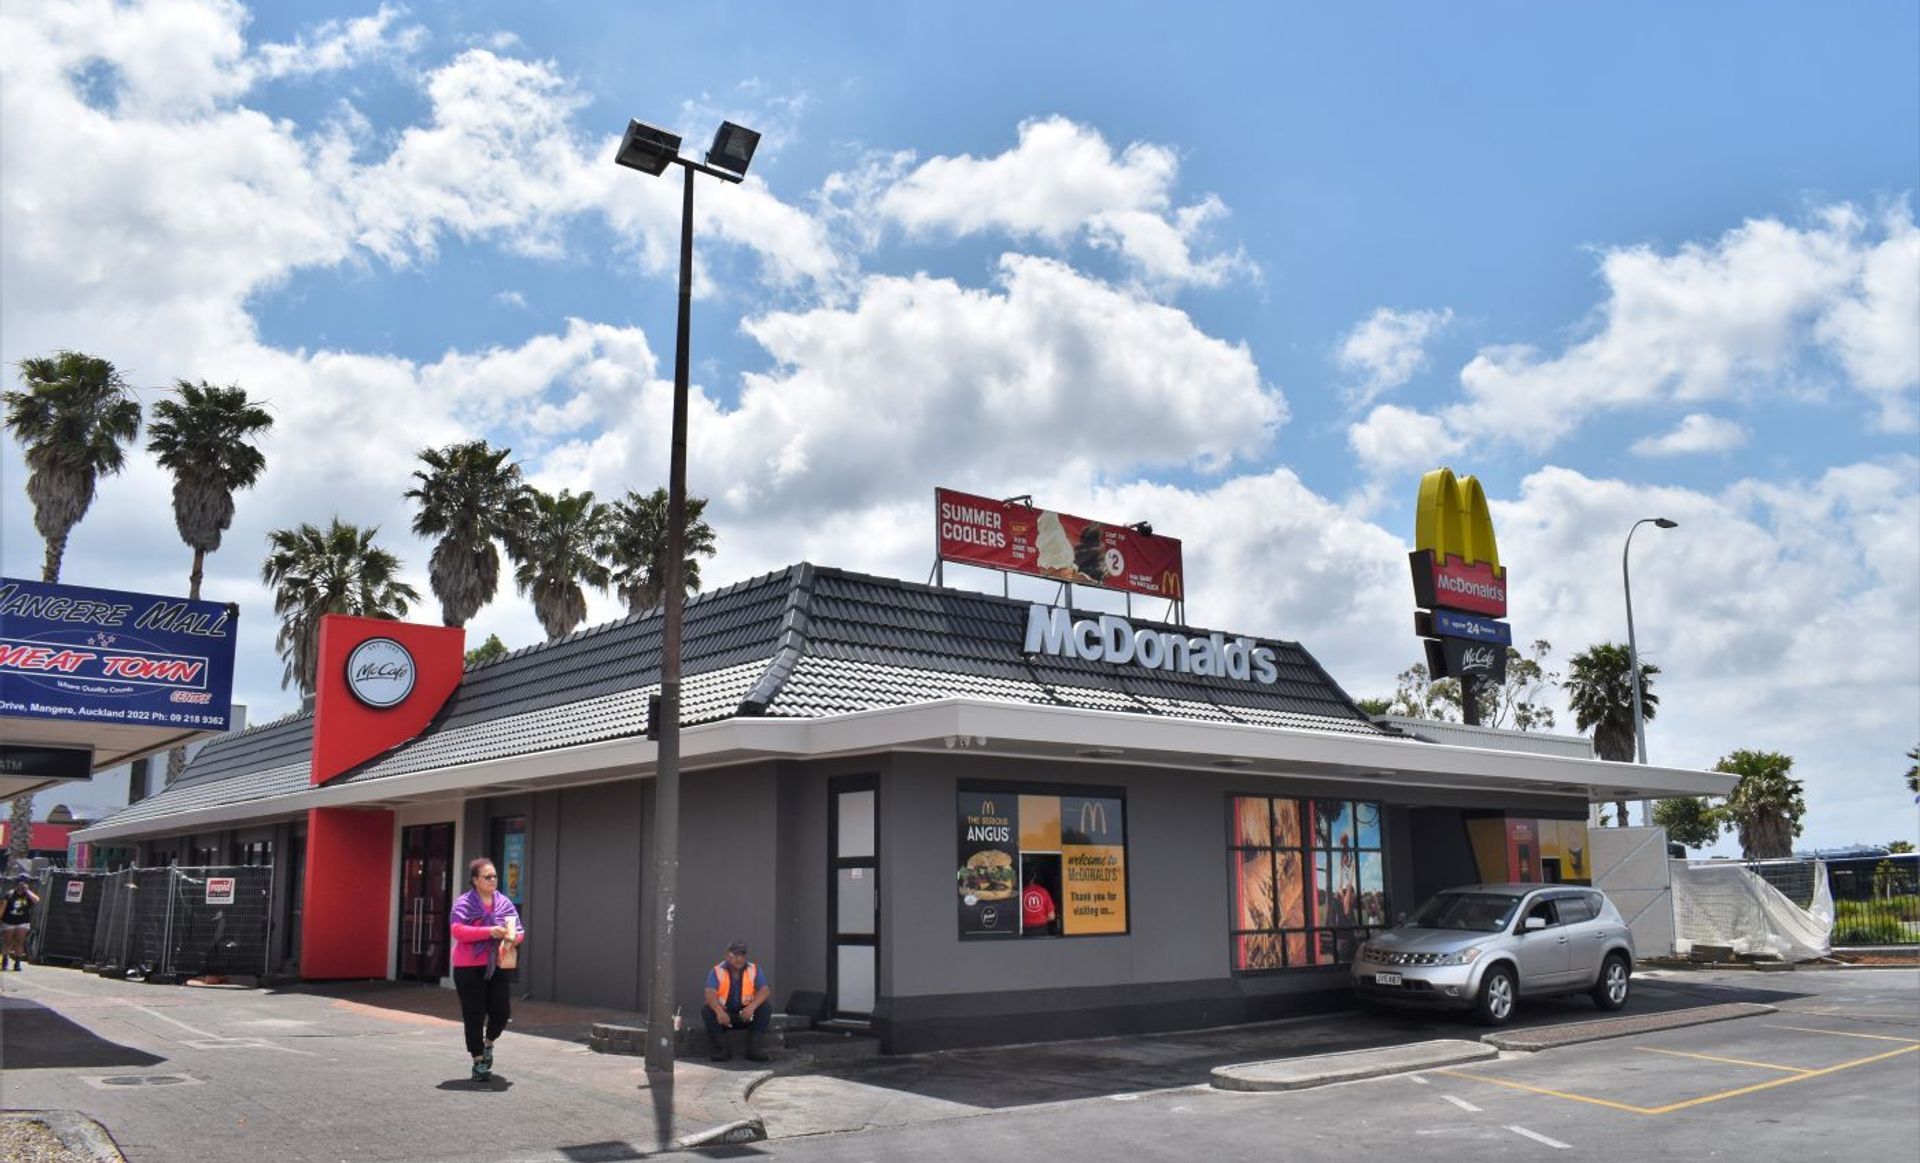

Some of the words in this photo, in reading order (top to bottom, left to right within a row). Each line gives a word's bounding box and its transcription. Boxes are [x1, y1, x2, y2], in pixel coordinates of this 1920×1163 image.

[942, 503, 1002, 529] SUMMER
[942, 522, 1007, 549] COOLERS
[1466, 621, 1480, 635] 24
[1024, 604, 1278, 684] McDonald's
[102, 656, 203, 683] TOWN
[57, 680, 81, 690] Where
[81, 685, 109, 694] Quality
[30, 703, 77, 715] Mangere,
[78, 707, 125, 719] Auckland
[127, 710, 150, 720] 2022
[152, 712, 168, 721] Ph:
[170, 713, 181, 722] 09
[184, 715, 200, 724] 218
[967, 825, 1009, 842] ANGUS
